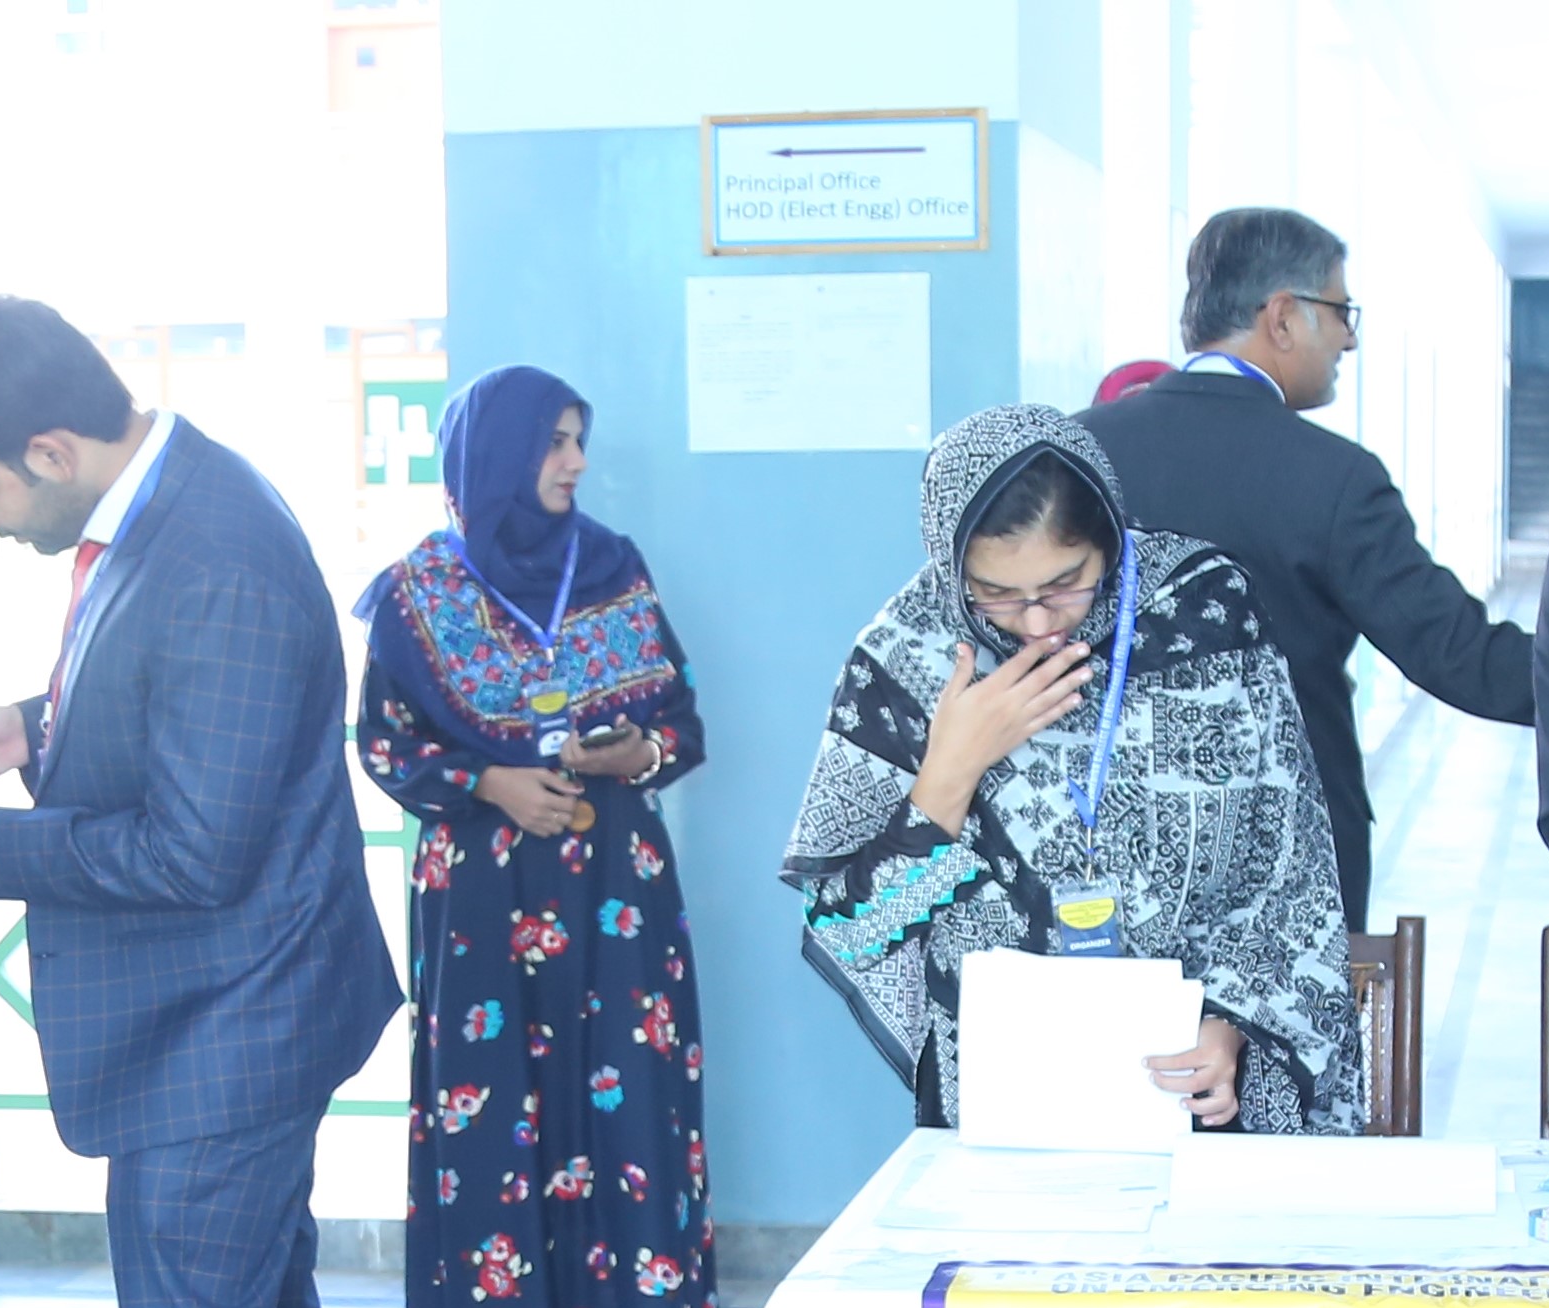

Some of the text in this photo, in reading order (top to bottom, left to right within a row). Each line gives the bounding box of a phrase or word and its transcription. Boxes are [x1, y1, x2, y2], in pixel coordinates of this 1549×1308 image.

[726, 172, 881, 194] Principal Office
[727, 197, 969, 221] HOD (Elect Engg) Office
[1053, 1272, 1152, 1283] ASIA
[1168, 1273, 1326, 1283] PACIFIC
[1051, 1283, 1109, 1294] ON
